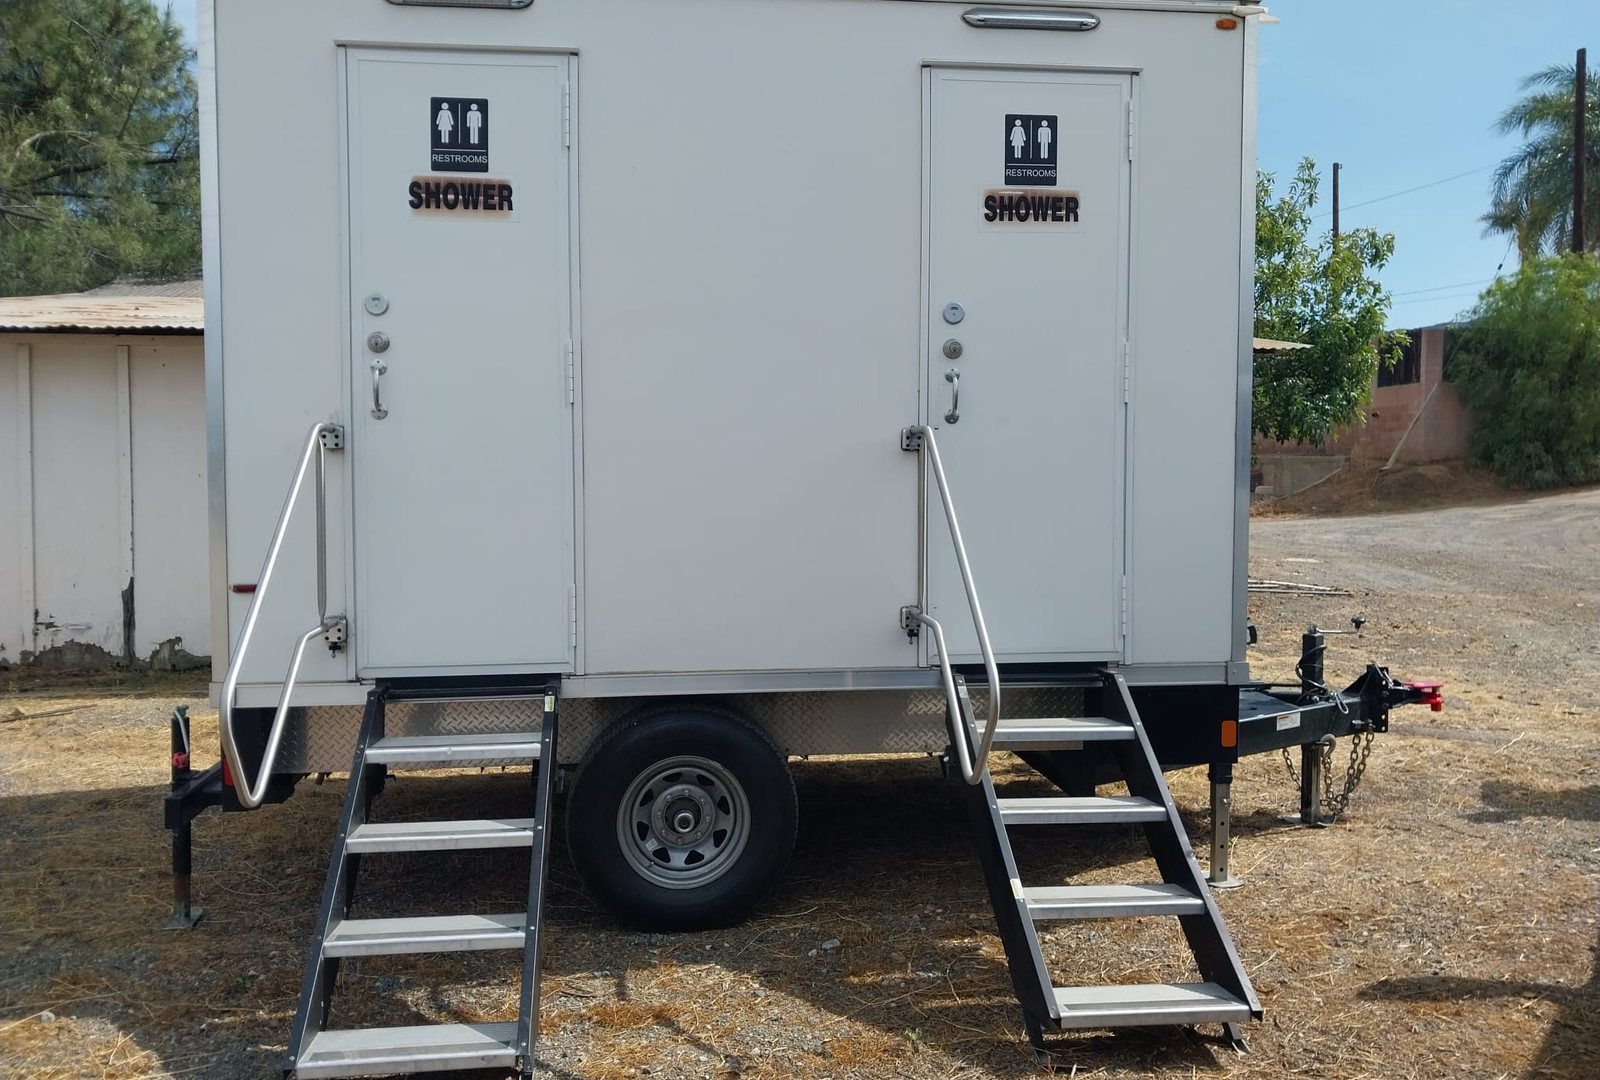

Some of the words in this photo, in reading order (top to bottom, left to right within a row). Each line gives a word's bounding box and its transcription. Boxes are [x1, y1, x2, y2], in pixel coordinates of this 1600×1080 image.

[432, 154, 488, 163] RESTROOMS
[1005, 169, 1057, 177] RESTROOMS
[408, 181, 513, 211] SHOWER
[984, 195, 1079, 222] SHOWER
